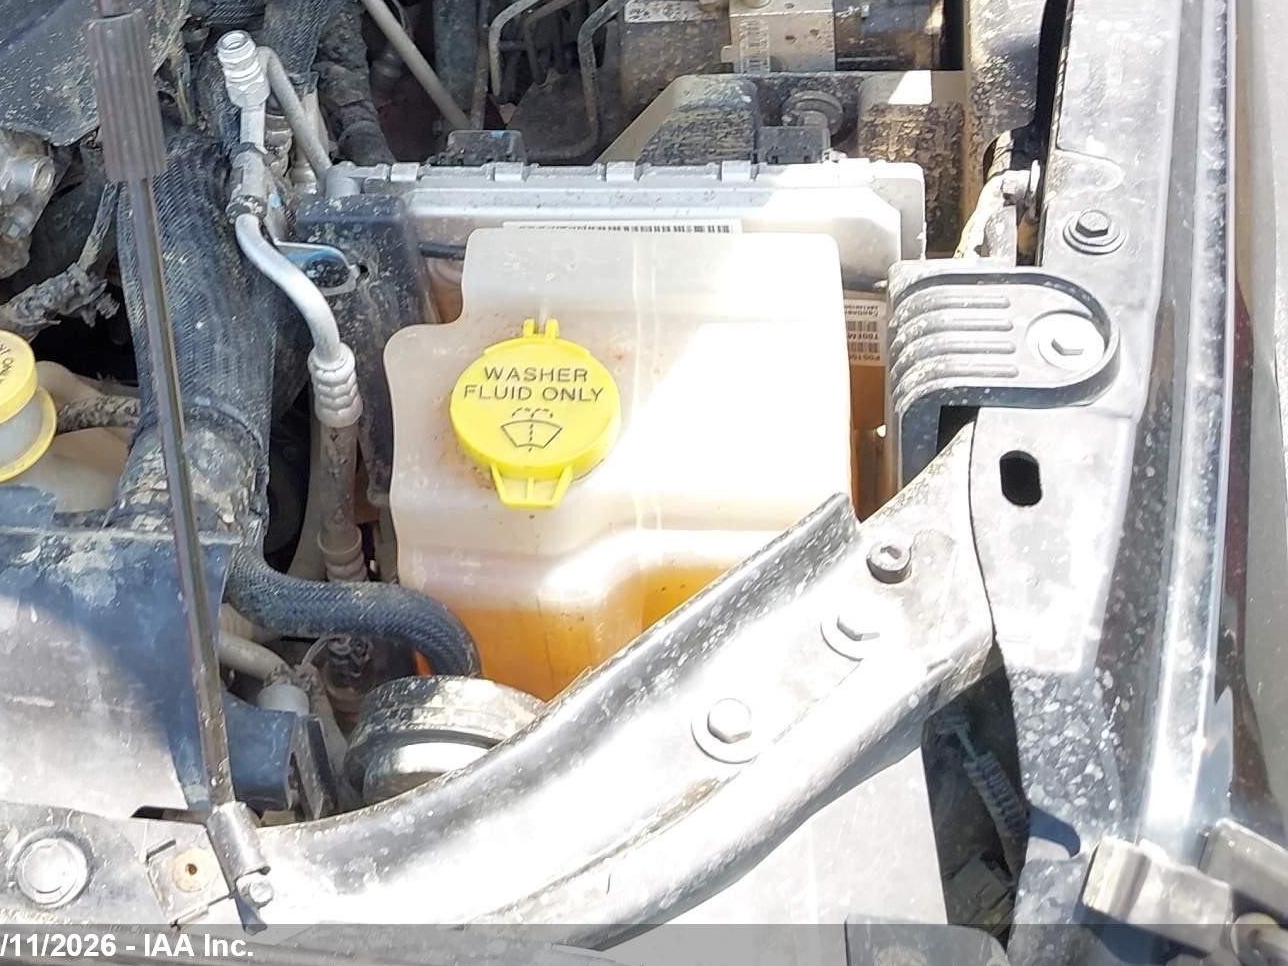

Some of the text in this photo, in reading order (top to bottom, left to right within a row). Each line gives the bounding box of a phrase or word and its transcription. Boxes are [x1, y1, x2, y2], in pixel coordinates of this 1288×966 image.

[484, 366, 588, 382] WASHER
[464, 384, 604, 403] FLUID ONLY
